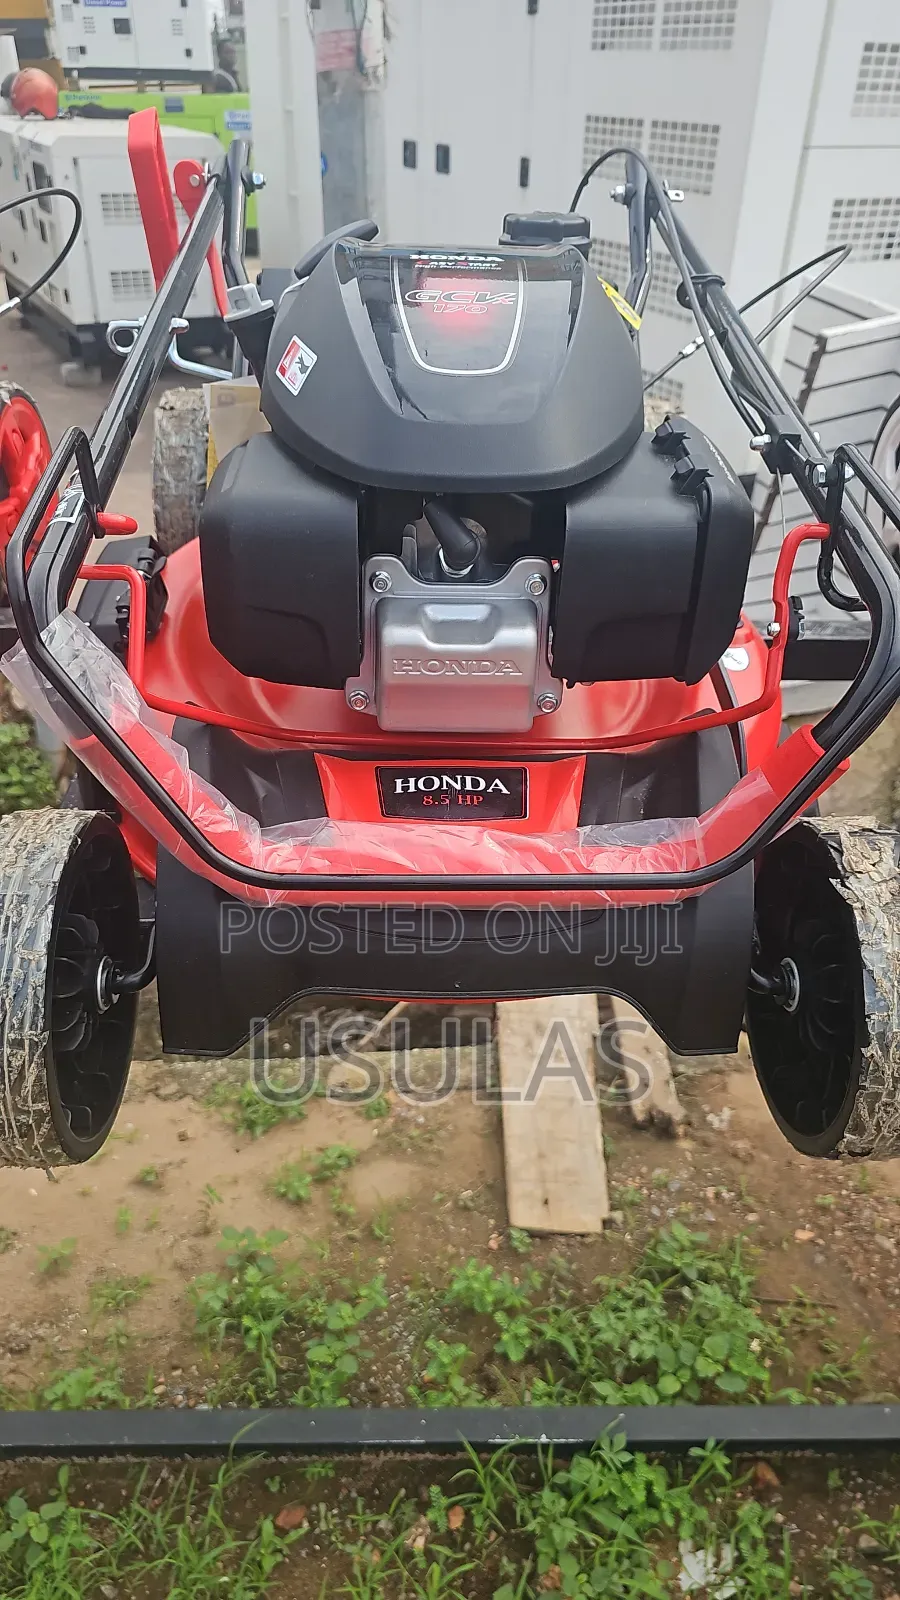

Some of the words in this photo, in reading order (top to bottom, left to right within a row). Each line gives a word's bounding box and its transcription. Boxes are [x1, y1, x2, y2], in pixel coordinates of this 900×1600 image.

[410, 254, 505, 262] HONDA
[433, 303, 487, 314] 170
[393, 658, 523, 676] HONDA
[394, 775, 510, 794] HONDA
[422, 794, 449, 806] 8.5
[457, 794, 484, 806] HP
